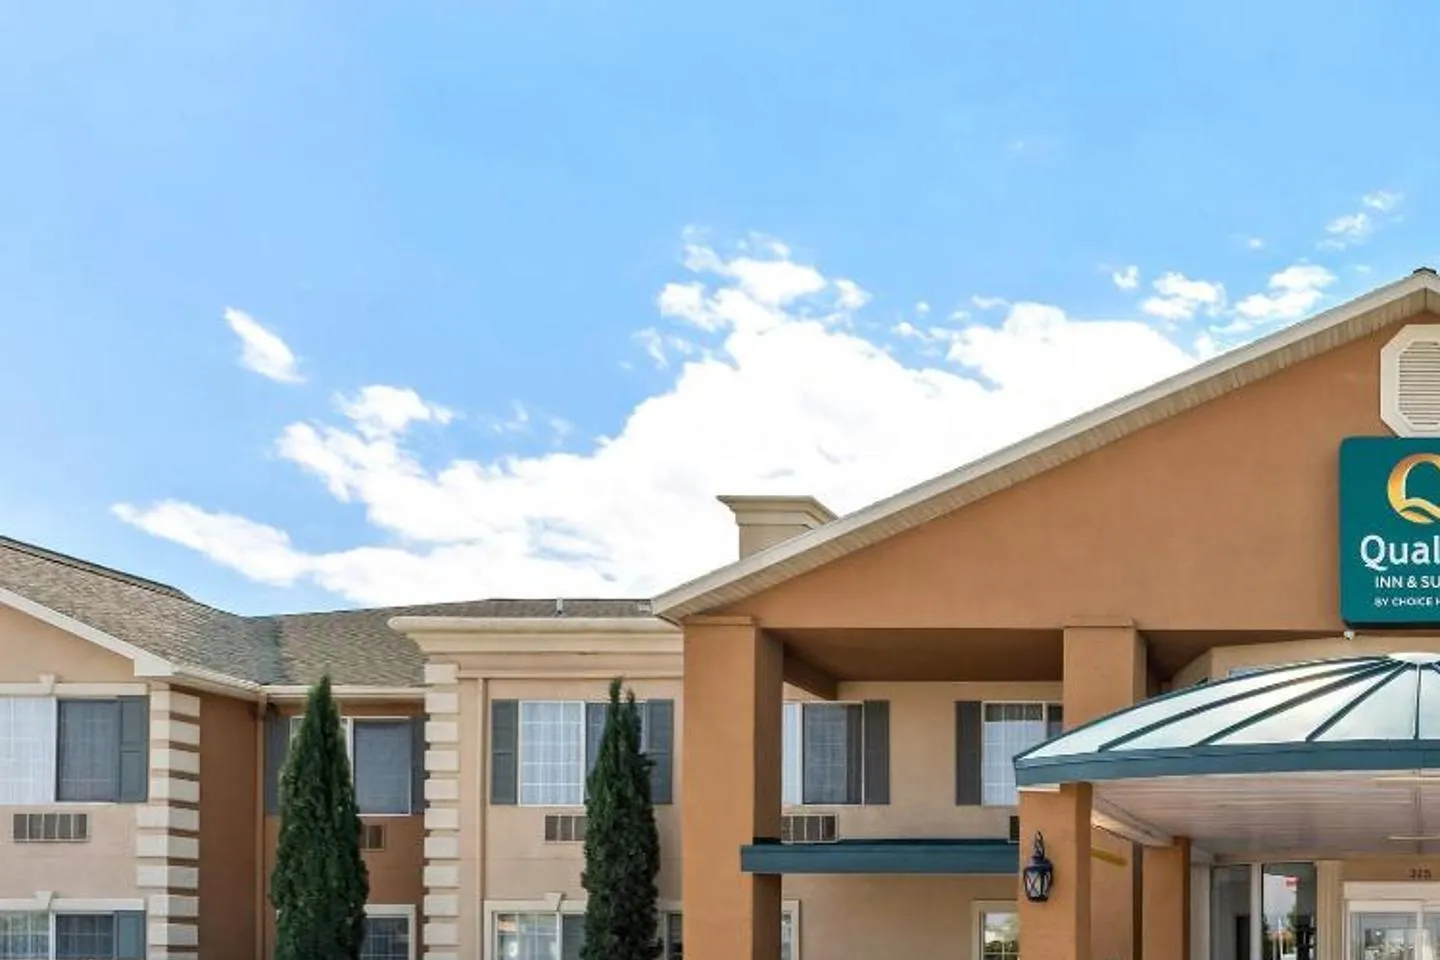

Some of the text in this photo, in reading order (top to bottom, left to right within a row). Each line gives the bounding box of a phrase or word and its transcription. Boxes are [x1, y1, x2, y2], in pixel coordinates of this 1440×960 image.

[1375, 575, 1403, 588] INN
[1406, 575, 1418, 588] &
[1374, 596, 1389, 607] BY
[1391, 596, 1433, 607] CHOICE
